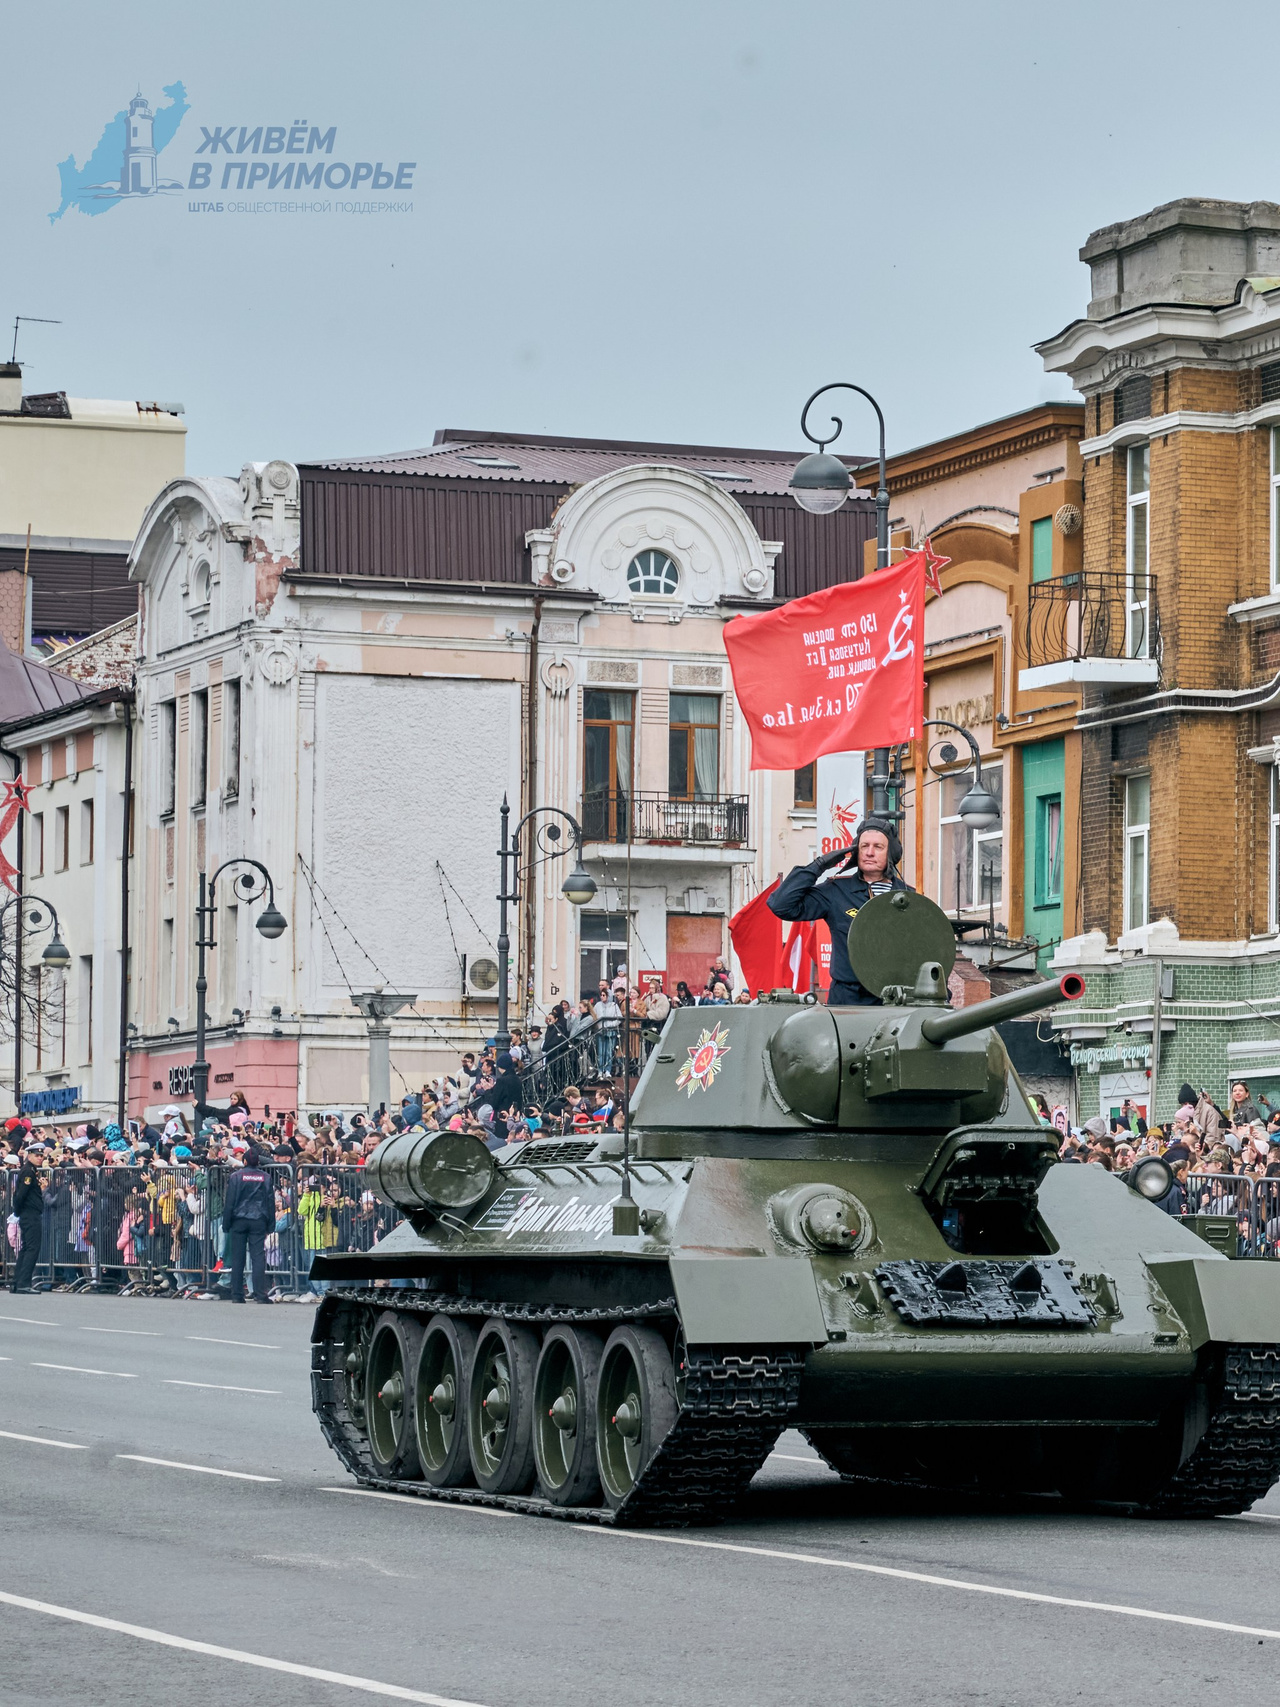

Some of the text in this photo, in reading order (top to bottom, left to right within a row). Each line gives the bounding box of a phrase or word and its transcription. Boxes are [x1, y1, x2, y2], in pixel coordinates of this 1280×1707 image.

[821, 836, 842, 855] 80
[169, 1063, 211, 1096] RESPE
[501, 1193, 622, 1241] Ефим Гольдбер
